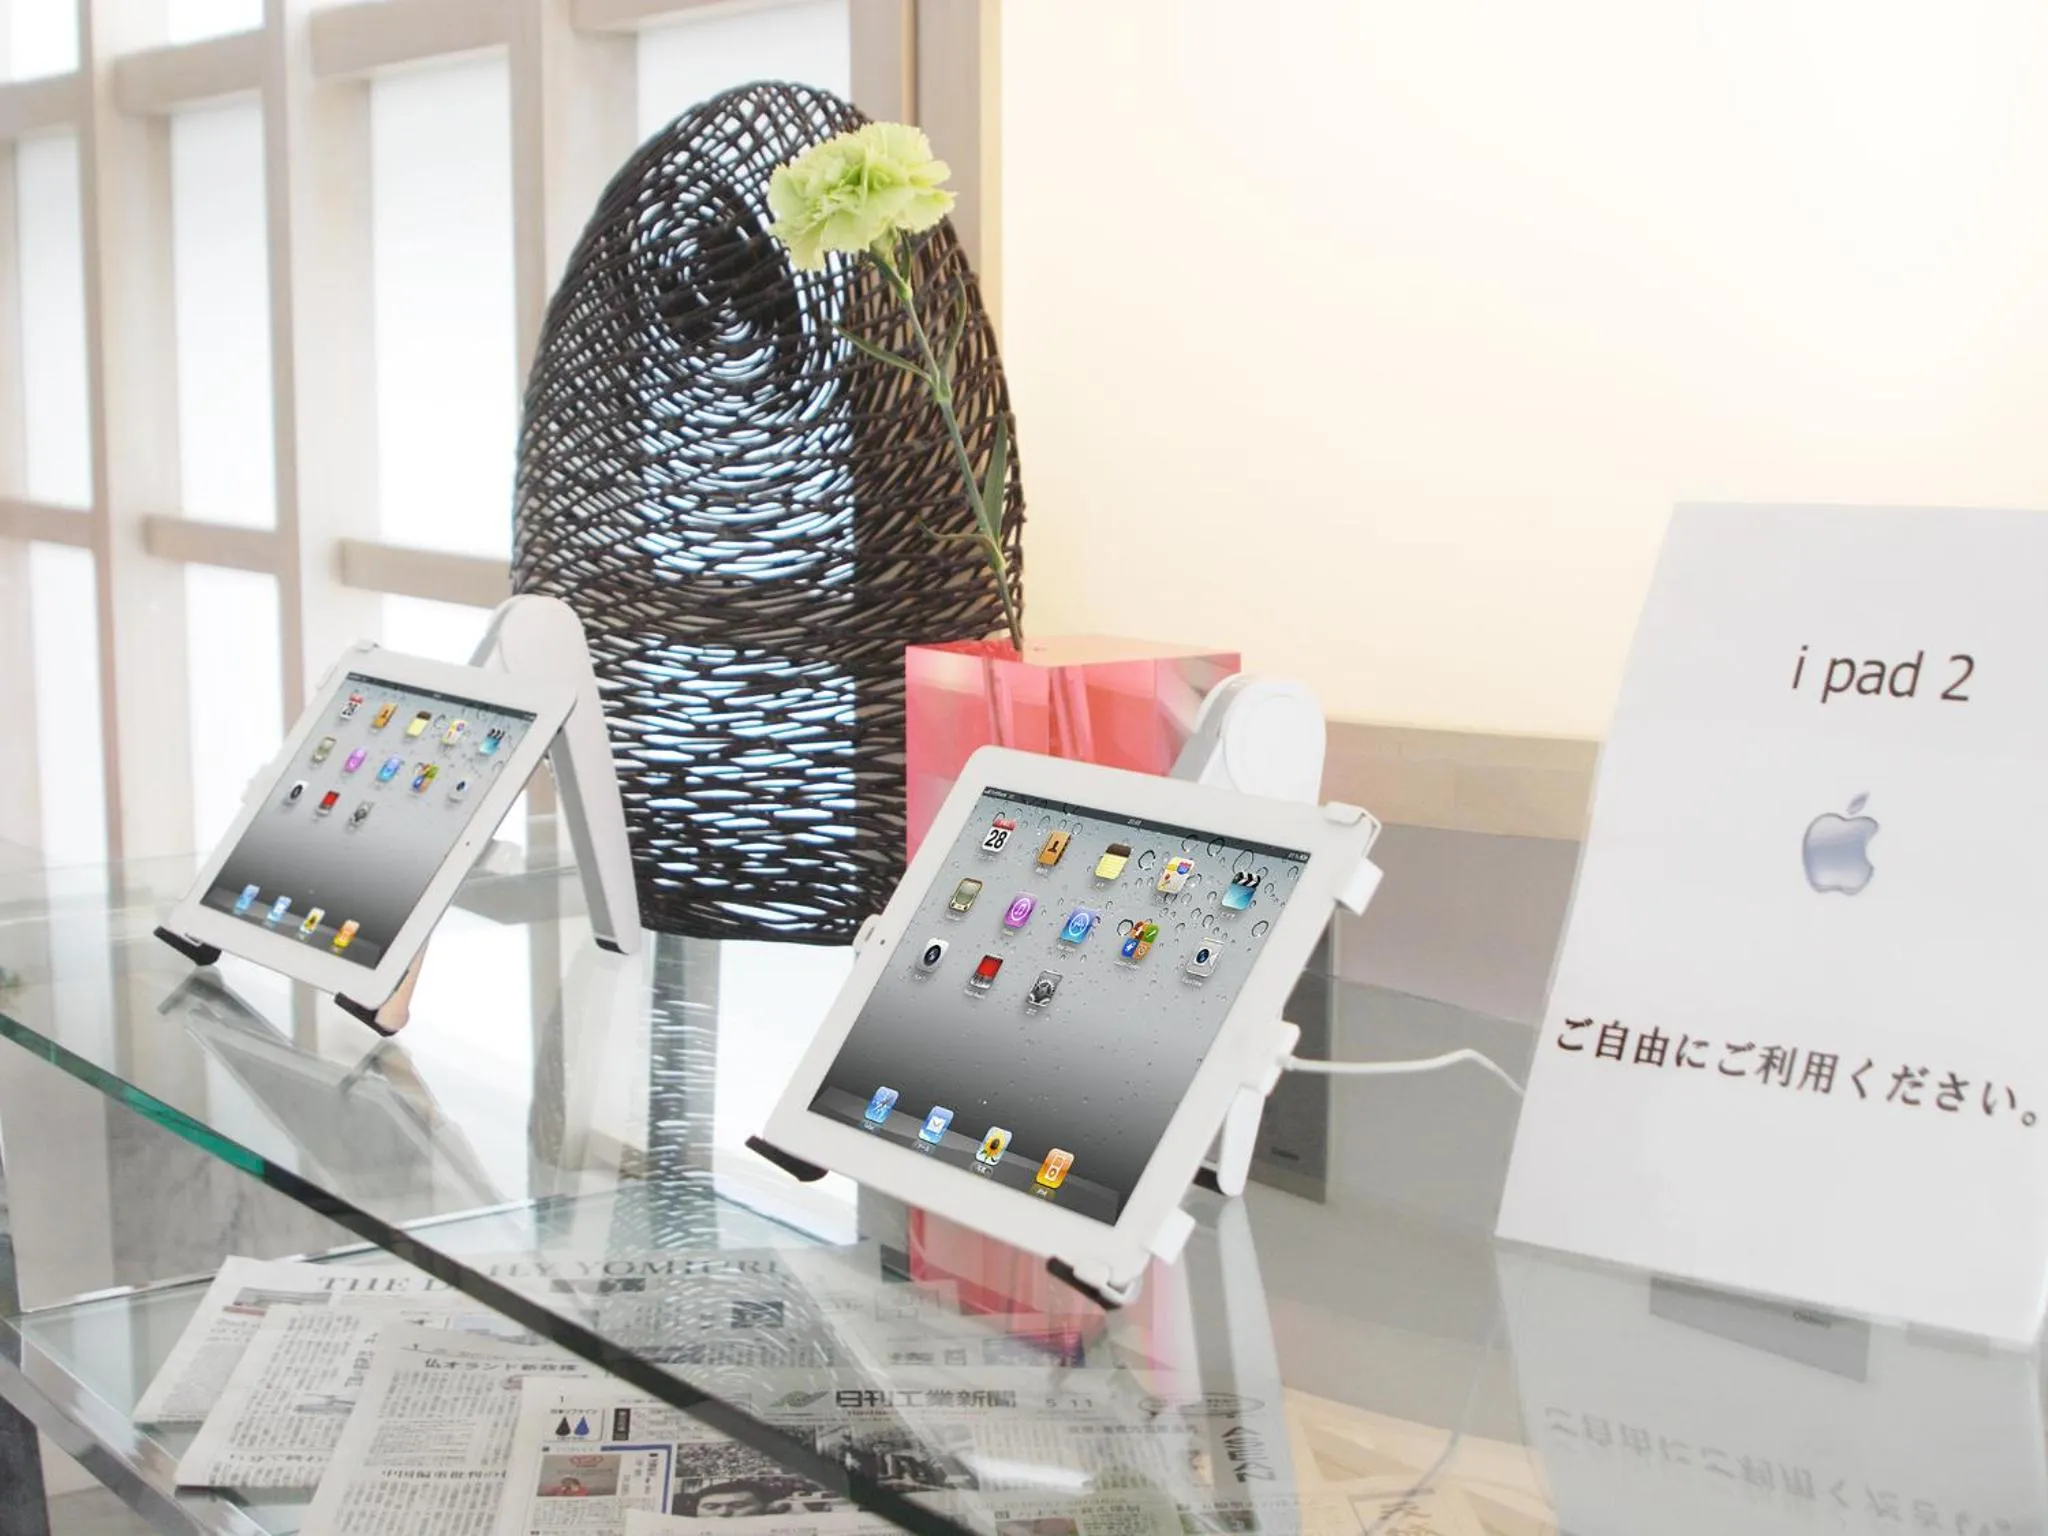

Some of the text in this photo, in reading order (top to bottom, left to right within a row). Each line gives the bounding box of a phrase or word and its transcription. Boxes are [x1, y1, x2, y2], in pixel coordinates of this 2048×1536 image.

[1790, 645, 1976, 704] i pad 2
[984, 829, 1008, 849] 28
[1555, 1016, 2039, 1128] ご自由にご利用ください。
[318, 1275, 407, 1292] THE
[835, 1389, 1016, 1408] 日刊工業新聞
